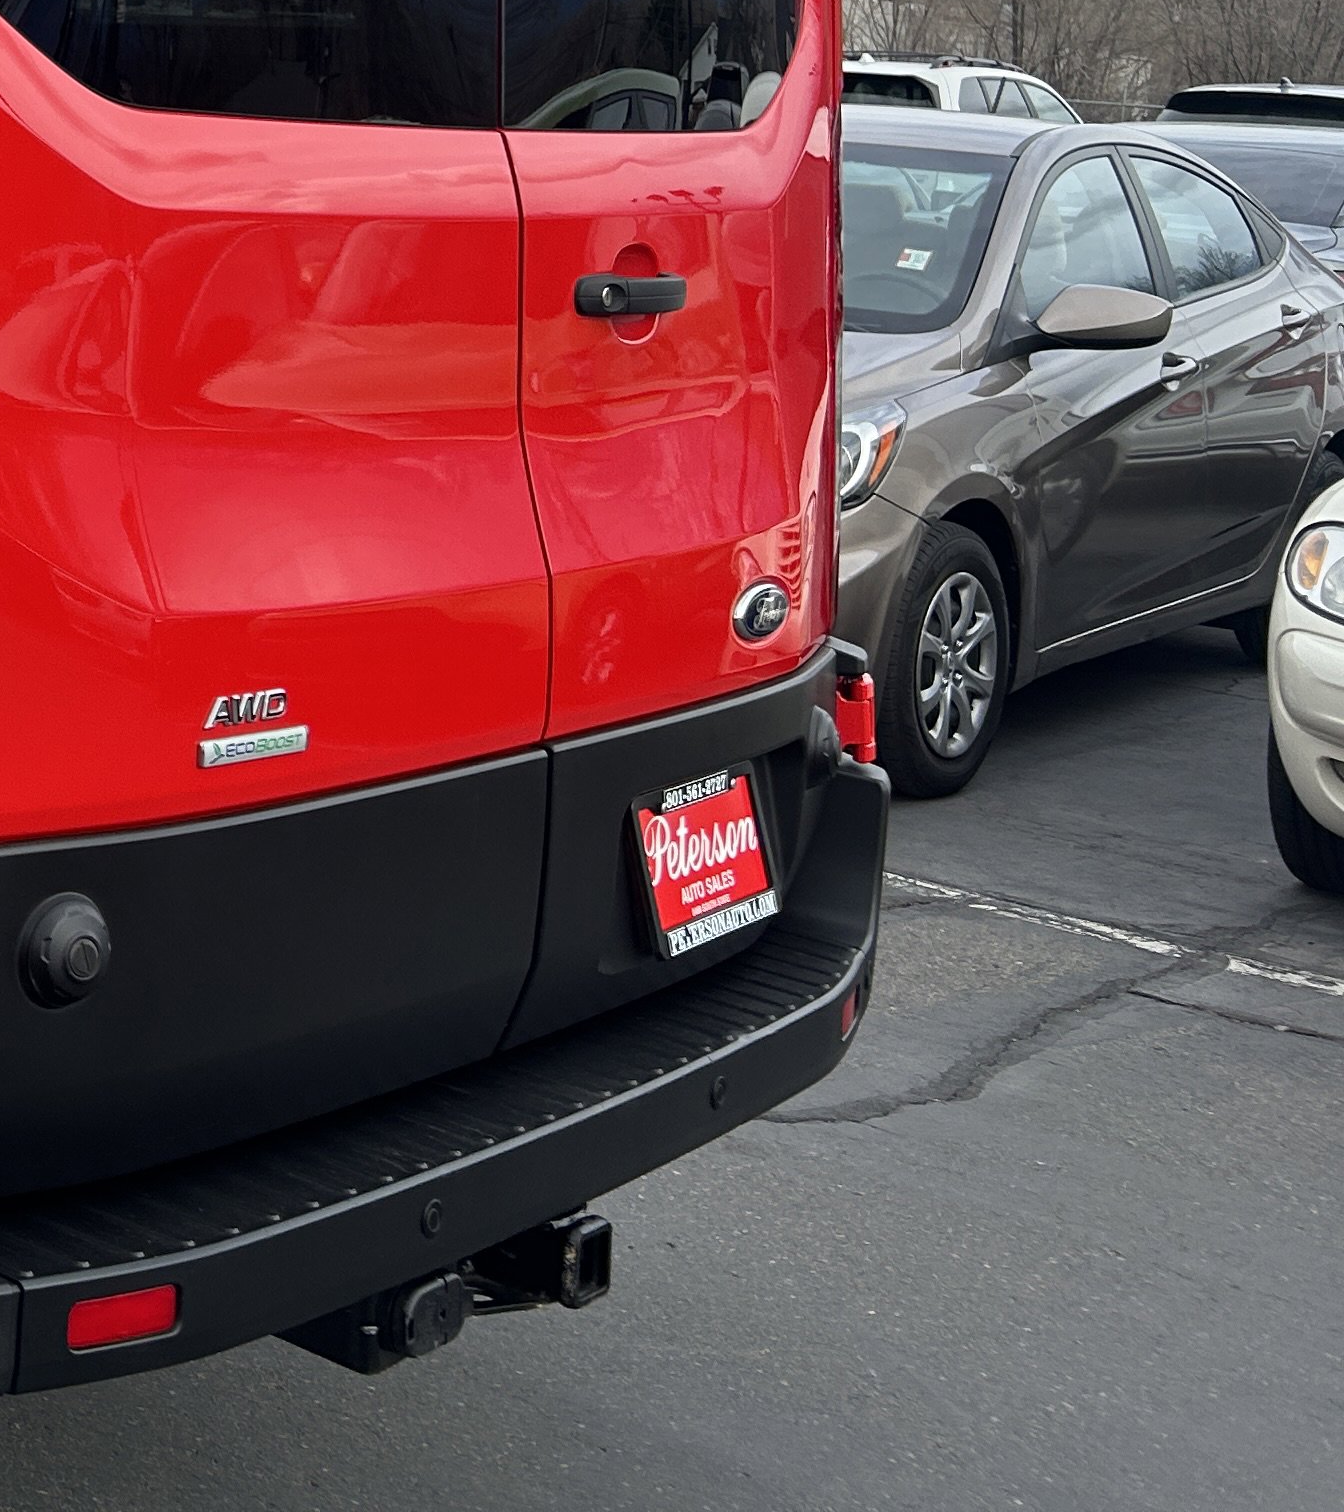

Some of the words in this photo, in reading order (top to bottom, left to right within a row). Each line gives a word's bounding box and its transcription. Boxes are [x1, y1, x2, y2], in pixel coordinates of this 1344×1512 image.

[203, 688, 287, 730] AWD
[225, 733, 303, 758] ECOBOOST
[643, 815, 759, 886] Peterson
[681, 881, 705, 905] AUTO
[705, 869, 736, 895] SALES
